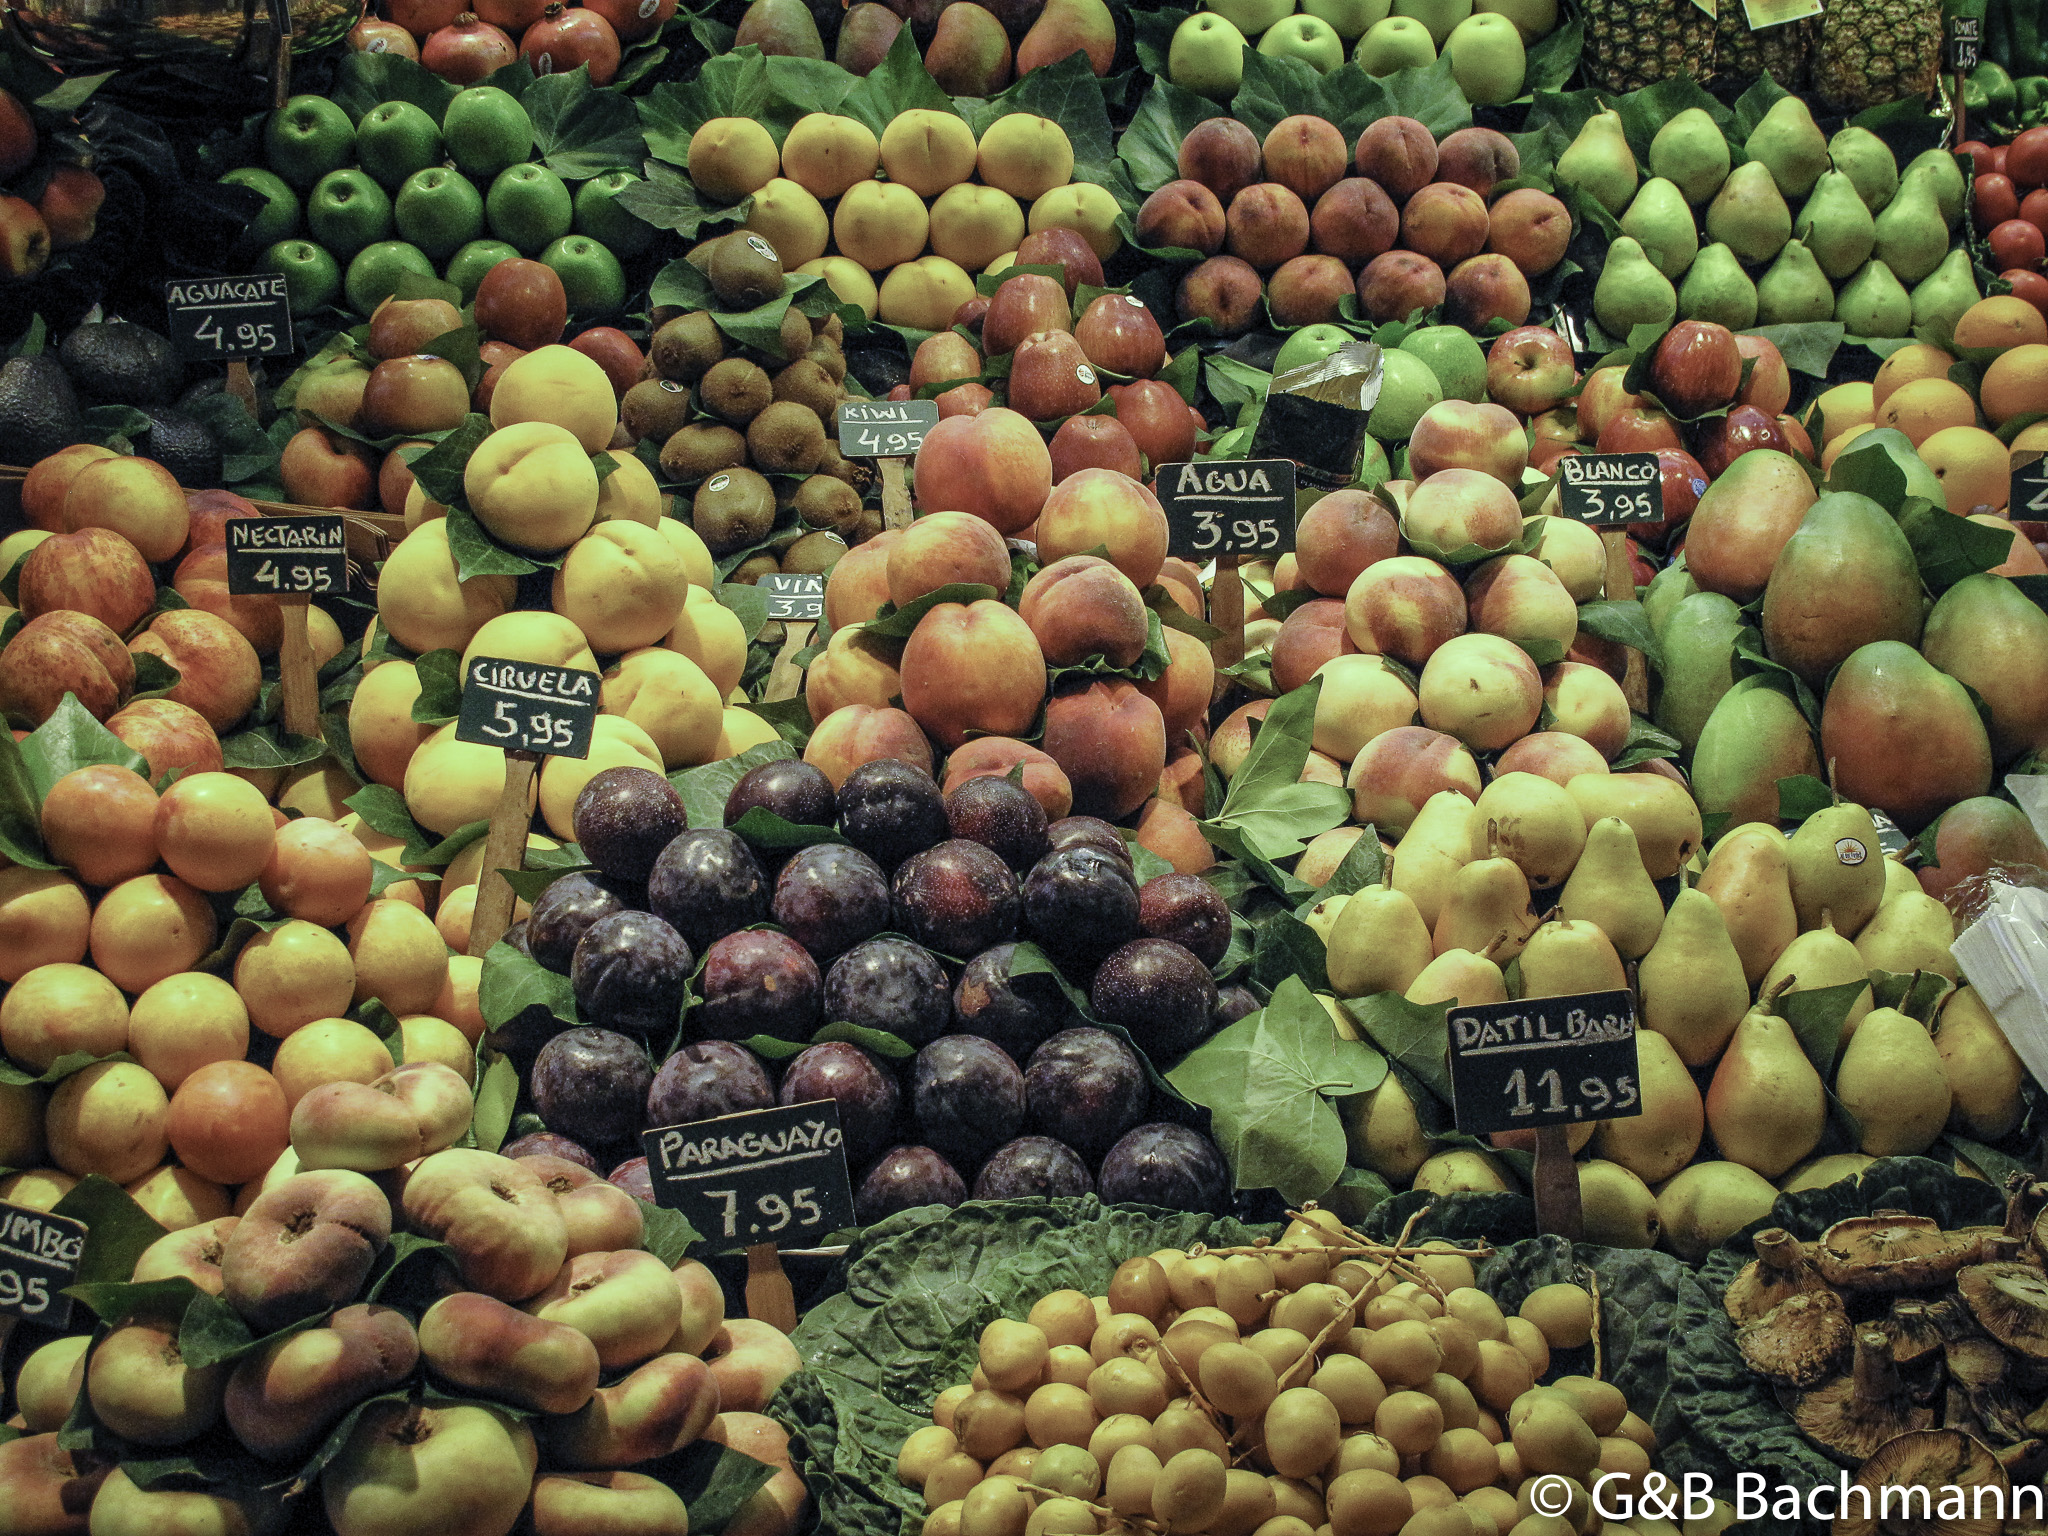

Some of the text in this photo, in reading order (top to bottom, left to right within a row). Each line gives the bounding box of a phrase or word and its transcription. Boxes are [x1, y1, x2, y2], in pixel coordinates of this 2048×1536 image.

[168, 279, 286, 304] AGUACATE
[195, 315, 276, 352] 4.95
[857, 428, 924, 454] 4,95
[1177, 463, 1272, 493] AGUA
[1562, 456, 1658, 482] BLANCO
[1580, 488, 1652, 521] 3,95
[1192, 511, 1280, 551] 3,95
[253, 560, 332, 592] 4.95
[473, 662, 593, 696] CIRUELA
[481, 700, 574, 748] 5,95
[1452, 1013, 1563, 1049] DATIL
[1503, 1068, 1638, 1118] 11,95
[660, 1119, 843, 1170] PARAGUAYO
[703, 1187, 822, 1237] 7.95
